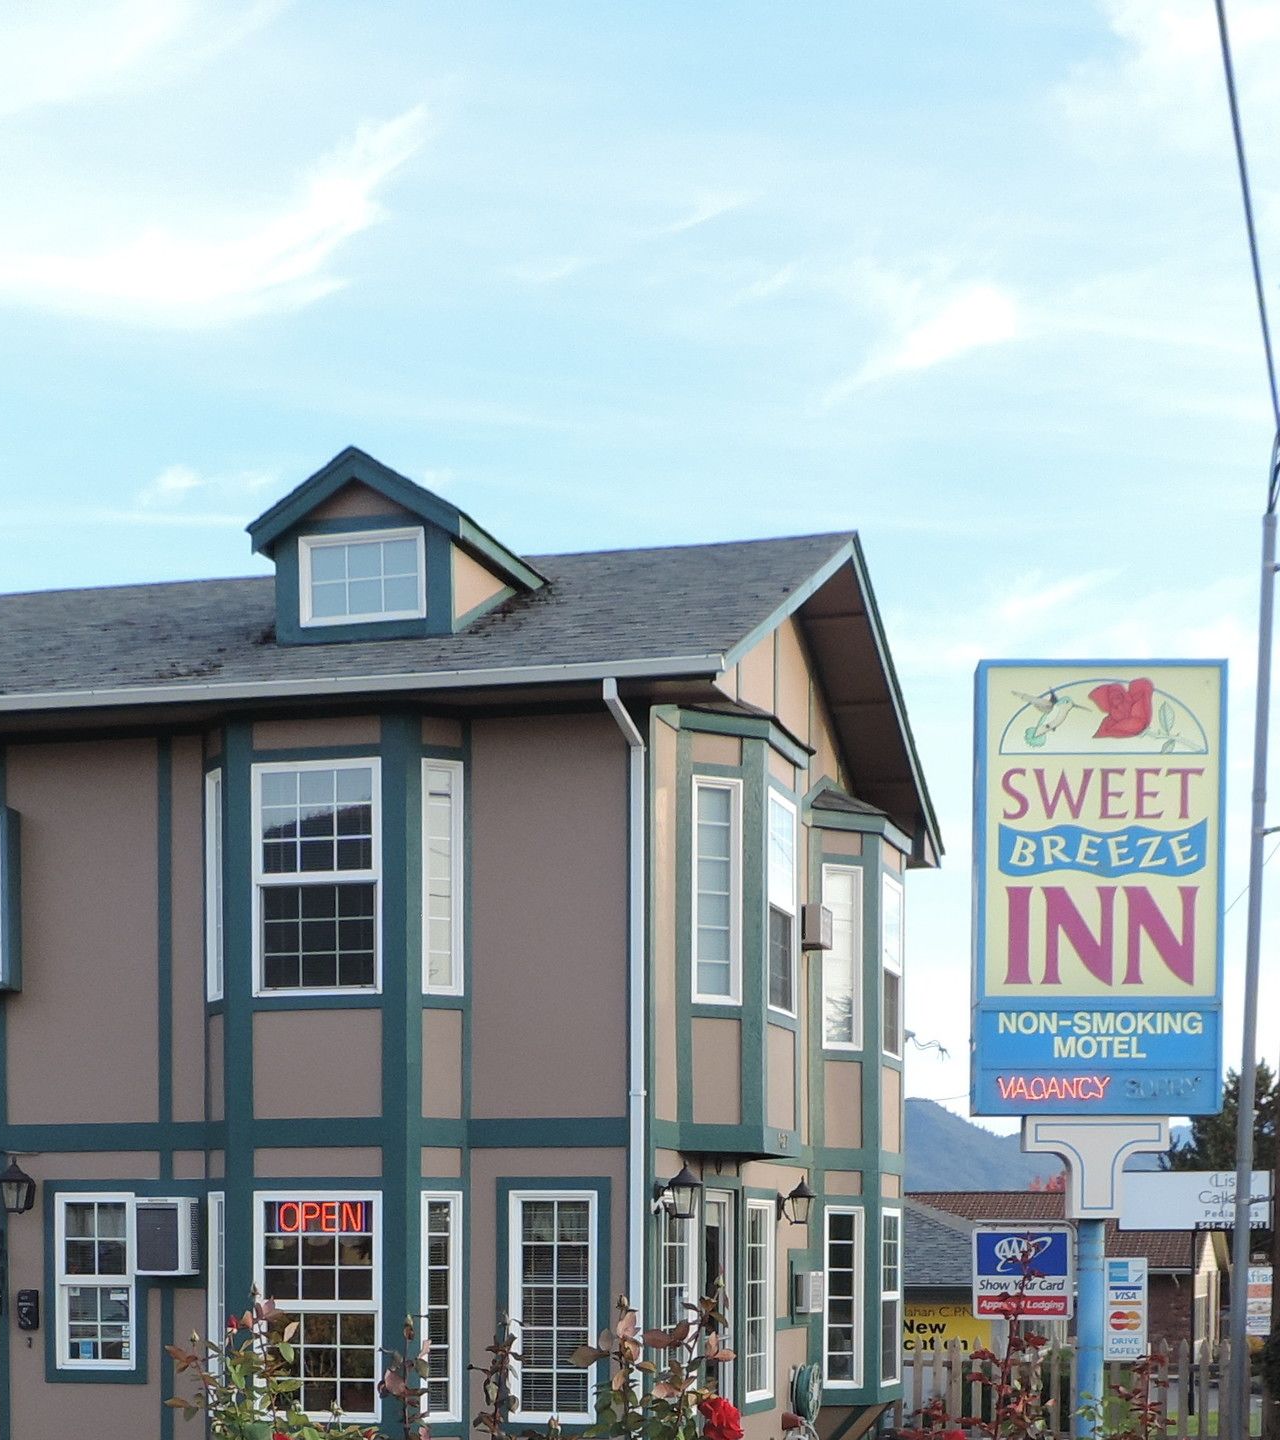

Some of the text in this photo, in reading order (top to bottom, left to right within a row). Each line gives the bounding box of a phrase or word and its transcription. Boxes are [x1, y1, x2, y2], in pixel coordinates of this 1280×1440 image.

[1001, 767, 1205, 820] SWEET
[1009, 833, 1199, 868] BREEZE
[1004, 886, 1200, 986] INN
[998, 1011, 1203, 1035] NON-SMOKING
[1053, 1036, 1147, 1059] MOTEL
[996, 1077, 1111, 1099] VACANCY
[1215, 1174, 1236, 1187] Lis
[1198, 1190, 1267, 1204] Callaan
[279, 1202, 362, 1231] OPEN
[1205, 1210, 1259, 1218] Pedias
[979, 1280, 1010, 1291] Show
[1039, 1279, 1065, 1291] Card
[1115, 1291, 1137, 1300] VISA
[981, 1300, 1065, 1311] Apprd Lodging
[903, 1319, 947, 1335] New
[903, 1336, 968, 1351] catn
[1111, 1337, 1140, 1345] DRIVE
[1109, 1347, 1141, 1355] SAFELY
